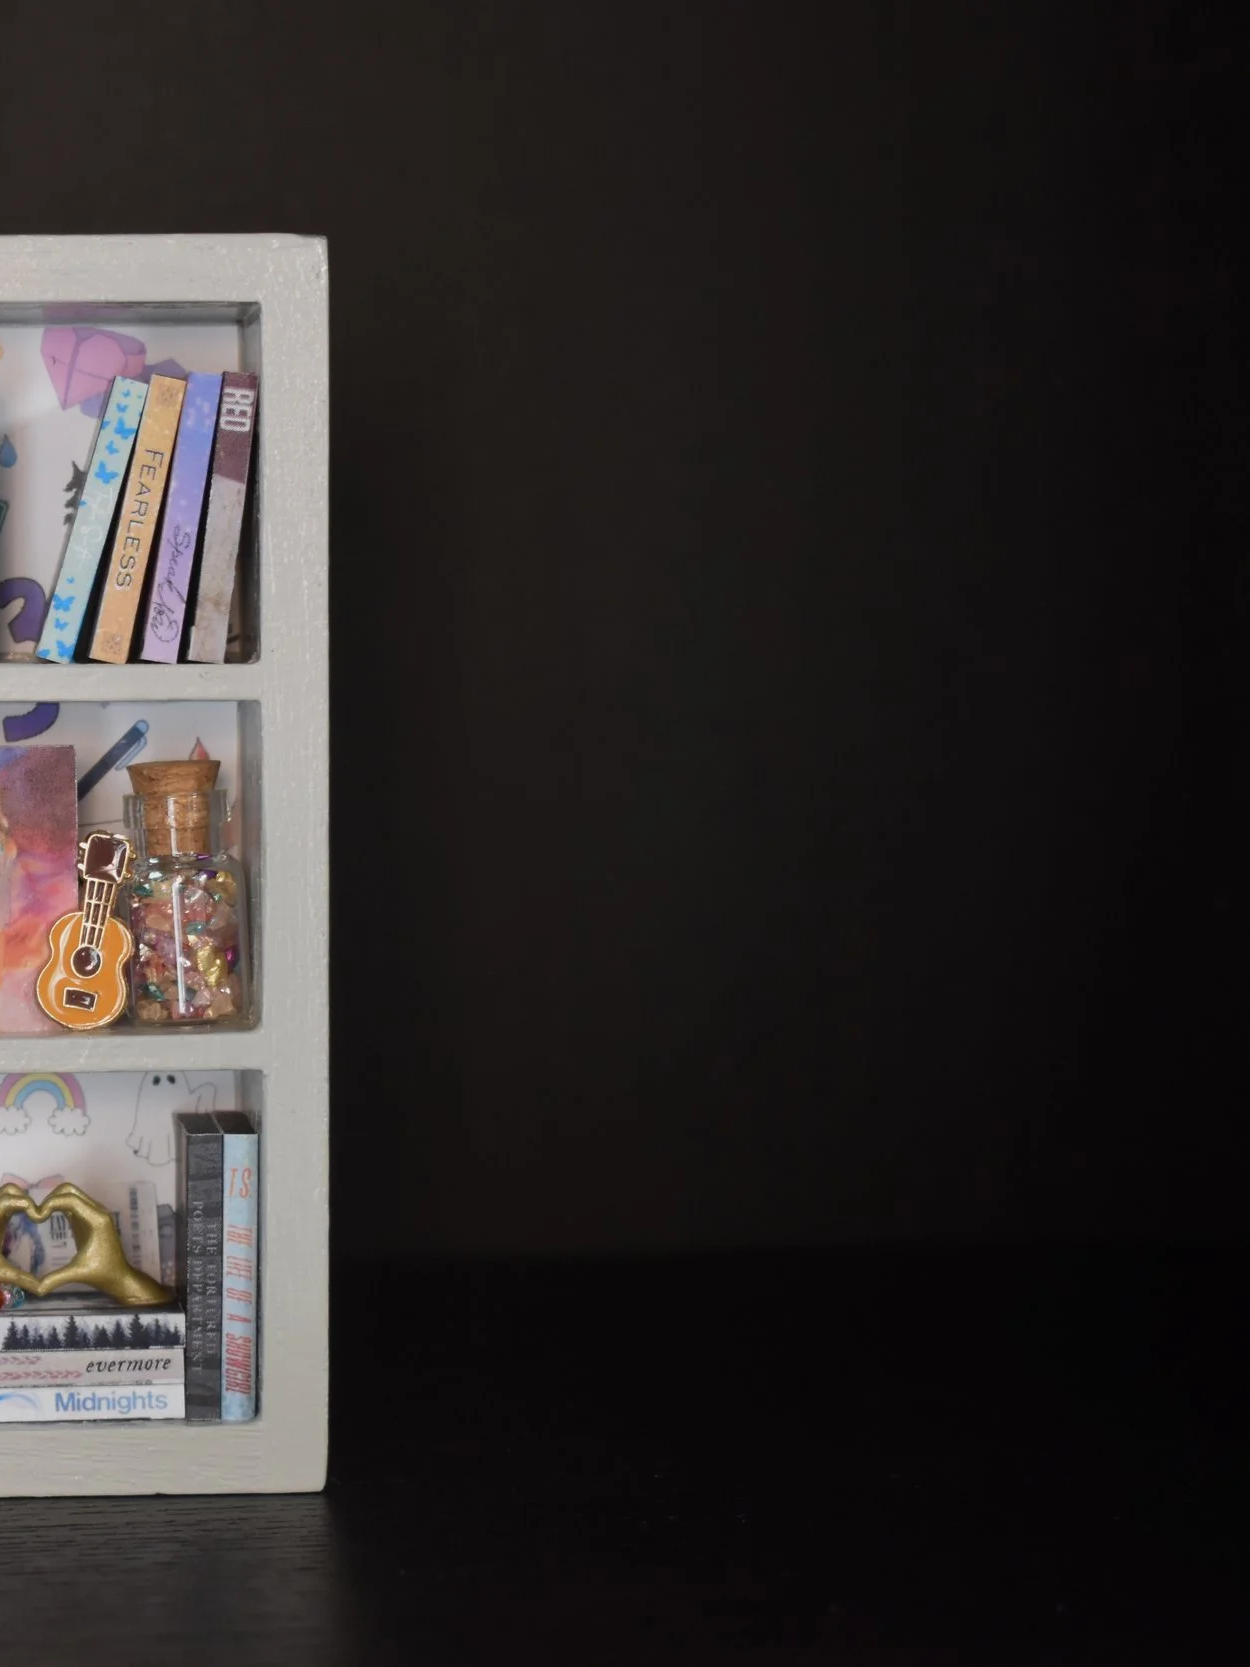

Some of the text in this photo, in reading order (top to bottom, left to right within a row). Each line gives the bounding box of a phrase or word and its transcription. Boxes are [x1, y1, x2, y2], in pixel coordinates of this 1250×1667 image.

[220, 388, 254, 432] RED
[116, 449, 164, 588] FEARLESS
[86, 1357, 172, 1373] evermore
[54, 1391, 168, 1414] Midnights
